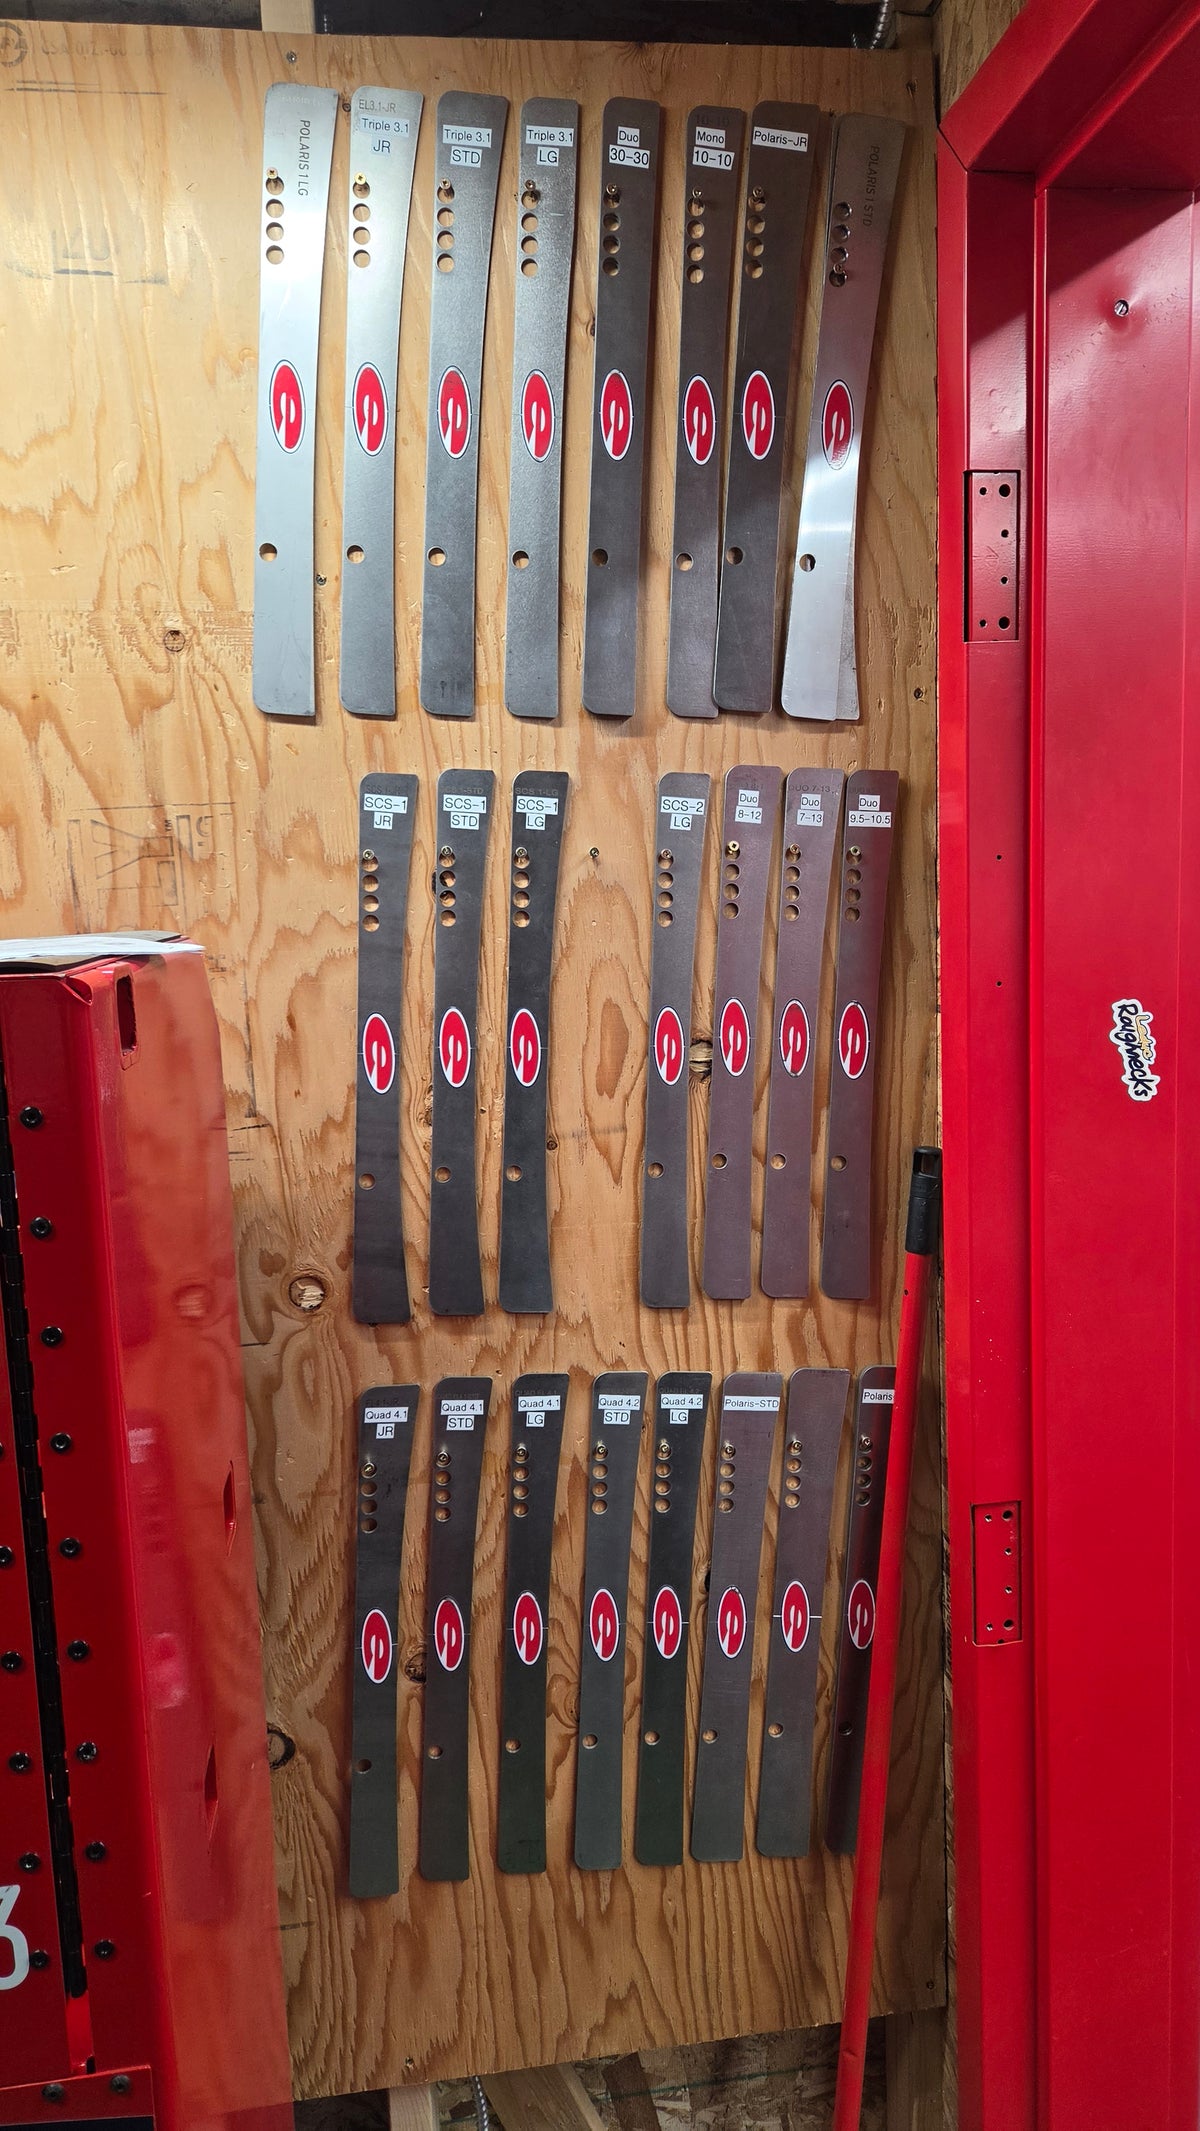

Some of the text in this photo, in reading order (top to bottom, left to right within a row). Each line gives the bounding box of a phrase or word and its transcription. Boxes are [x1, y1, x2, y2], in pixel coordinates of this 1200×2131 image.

[359, 98, 397, 114] EL3.1-JR
[362, 117, 409, 134] Triple 3.1
[444, 128, 491, 143] Triple 3.1
[528, 129, 573, 143] Triple 3.1
[618, 130, 639, 143] Duo
[697, 130, 725, 144] Mono
[754, 130, 807, 148] Polaris-JR
[298, 119, 311, 170] POLARIS
[373, 140, 391, 154] JR
[452, 149, 481, 165] STD
[539, 149, 558, 163] LG
[610, 150, 649, 166] 30-30
[694, 150, 732, 167] 10-10
[866, 145, 880, 194] POLARIS
[297, 182, 309, 196] LG
[862, 204, 873, 227] STD
[365, 796, 406, 811] SCS-1
[444, 797, 486, 810] SCS-1
[517, 798, 558, 811] SCS-1
[740, 793, 758, 804] Duo
[802, 796, 820, 807] Duo
[859, 797, 878, 808] Duo
[662, 799, 704, 813] SCS-2
[737, 808, 761, 820] 8-12
[800, 811, 822, 823] 7-13
[849, 813, 891, 825] 9.5-10.5
[375, 814, 391, 828] JR
[452, 815, 478, 828] STD
[527, 815, 544, 828] LG
[674, 816, 691, 828] LG
[1114, 1003, 1154, 1097] Roughnecks
[599, 1397, 640, 1407] Quad 4.2
[661, 1397, 702, 1407] Quad 4.2
[863, 1391, 893, 1401] Polaris
[442, 1403, 483, 1413] Quad 4.1
[519, 1399, 560, 1409] Quad 4.1
[725, 1398, 779, 1409] Polaris-STD
[366, 1410, 408, 1420] Quad 4.1
[527, 1414, 544, 1425] LG
[605, 1411, 629, 1422] STD
[671, 1411, 687, 1422] LG
[448, 1417, 474, 1429] STD
[378, 1425, 394, 1437] JR
